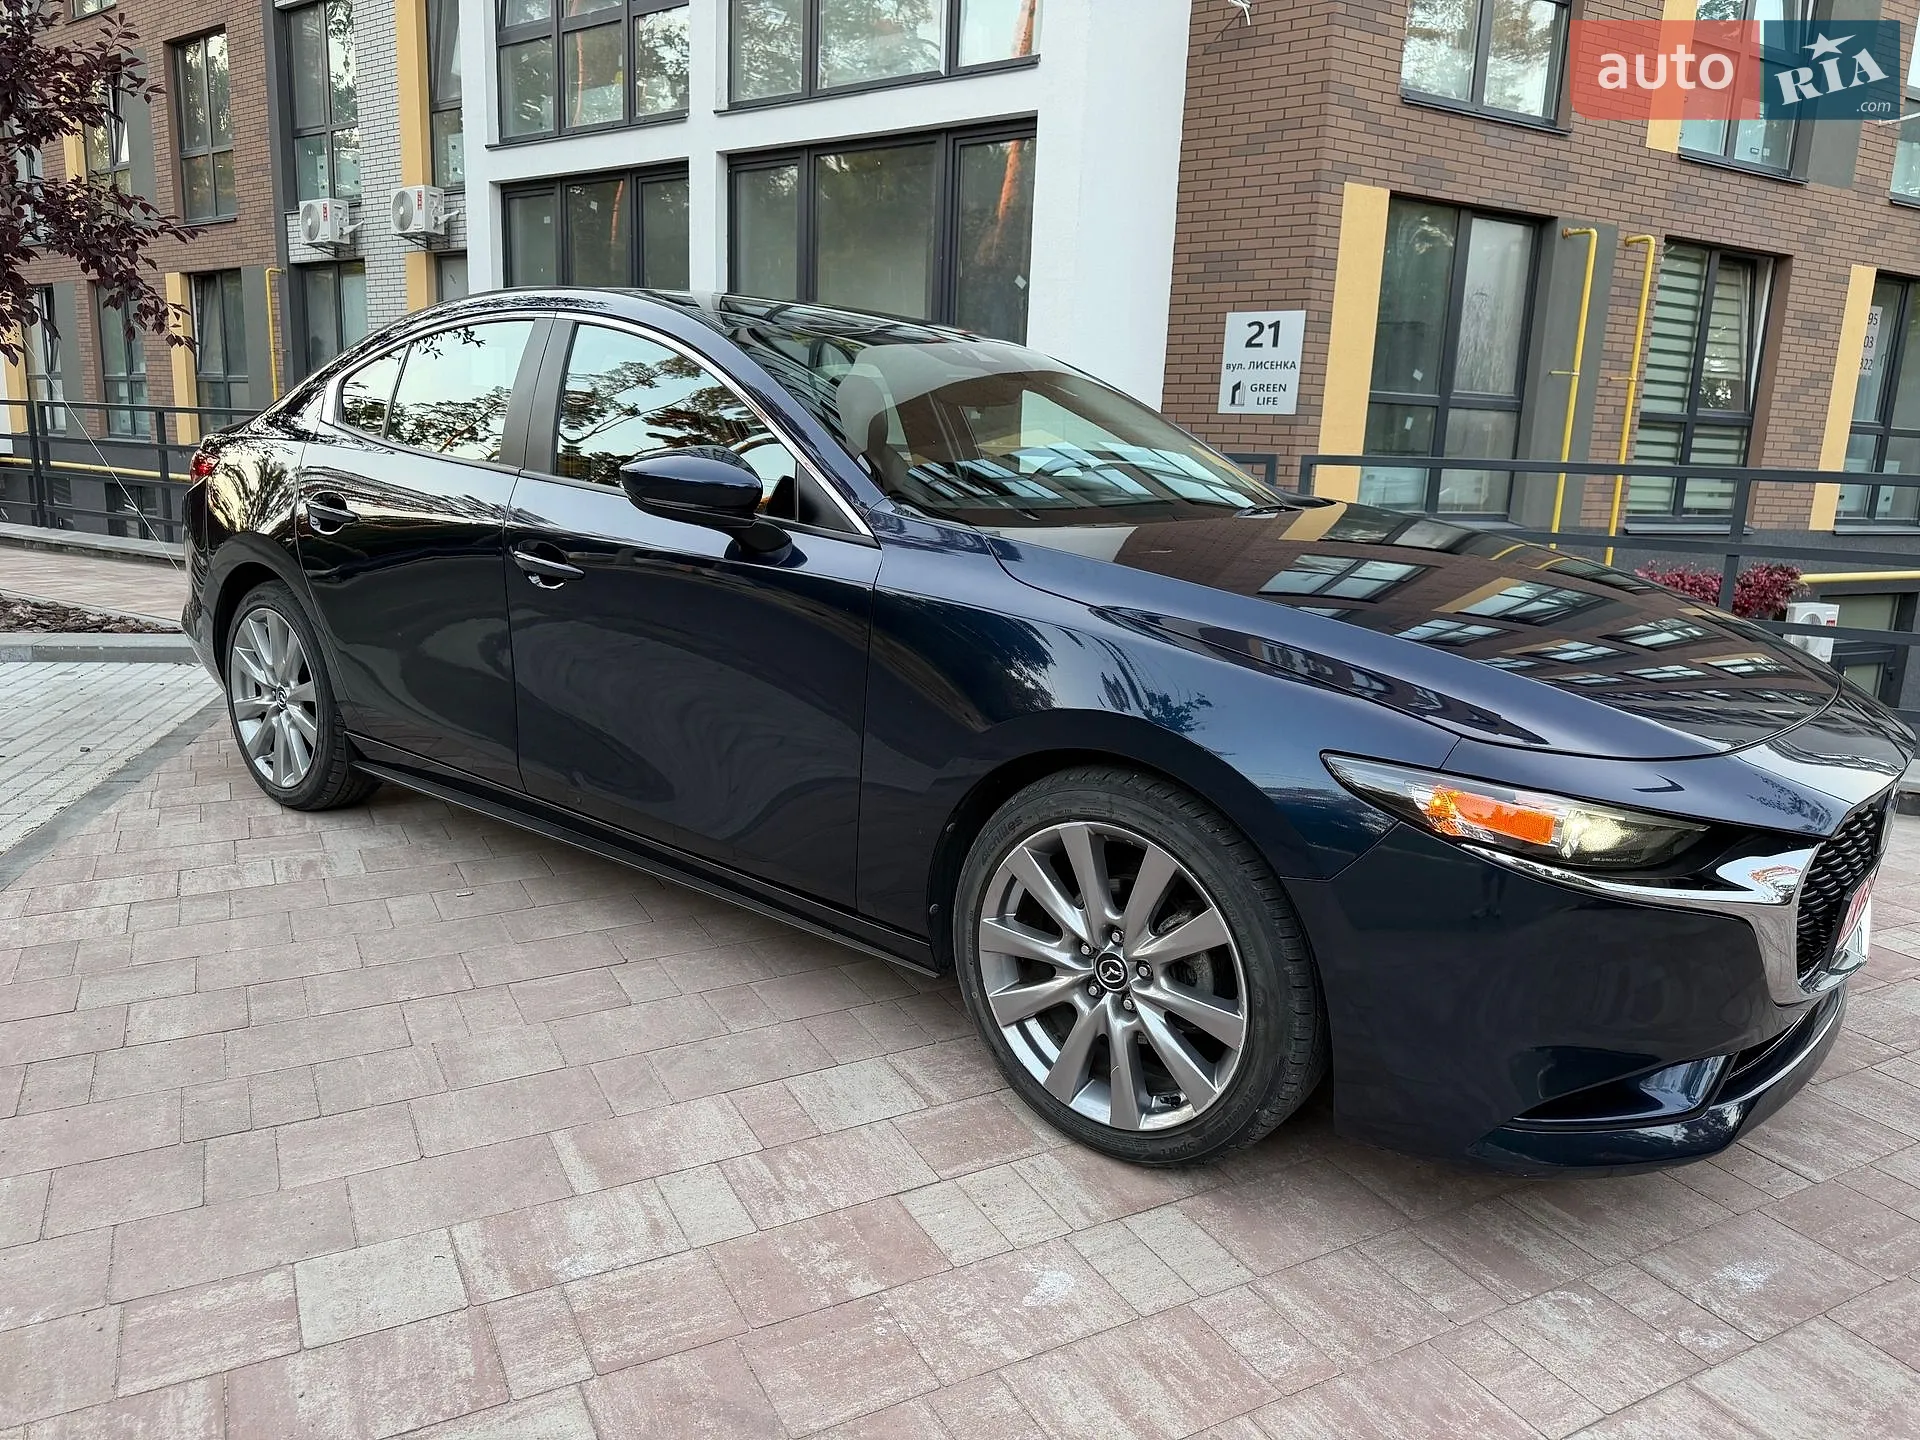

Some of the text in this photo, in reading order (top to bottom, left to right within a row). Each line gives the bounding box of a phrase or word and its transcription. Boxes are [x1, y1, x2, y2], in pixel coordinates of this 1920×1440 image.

[1245, 320, 1281, 348] 21
[1226, 361, 1297, 372] вул. ЛИСЕНКА
[1250, 384, 1287, 393] GREEN
[1256, 397, 1278, 406] LIFE
